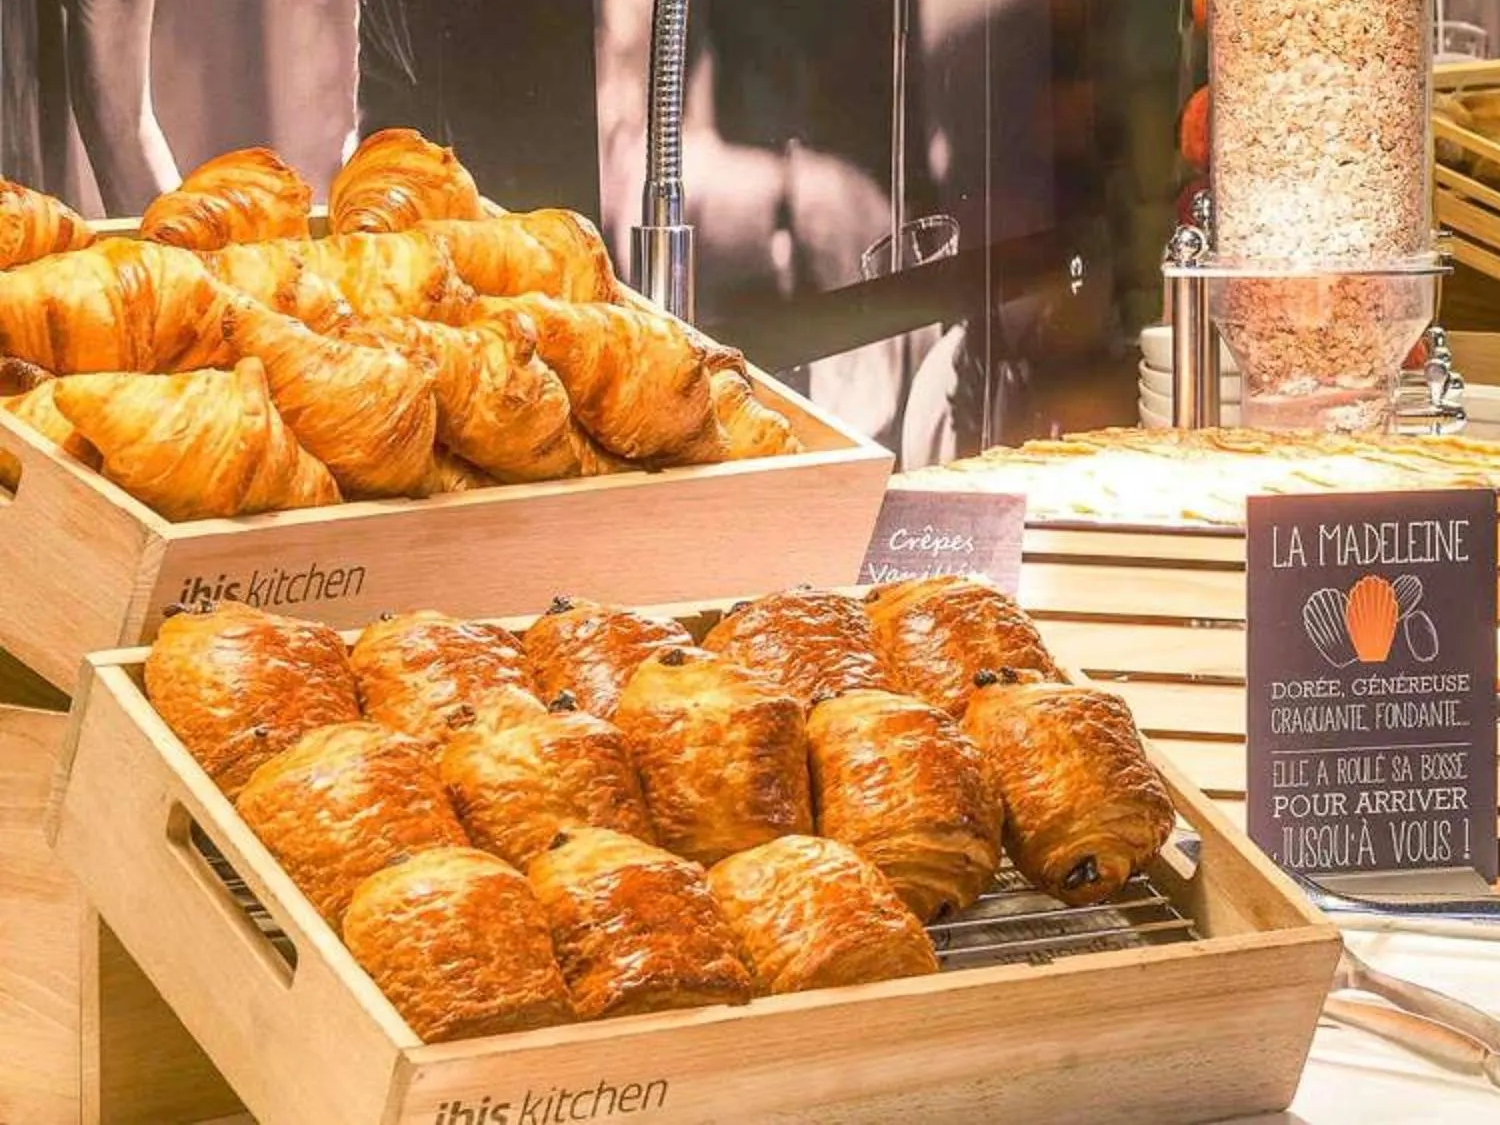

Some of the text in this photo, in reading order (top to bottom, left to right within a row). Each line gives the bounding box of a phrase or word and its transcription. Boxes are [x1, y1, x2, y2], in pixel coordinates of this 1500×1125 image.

[889, 525, 975, 557] Crêpes
[1272, 520, 1469, 568] LA MADELEINE
[246, 563, 366, 609] kitchen
[1272, 673, 1471, 700] DORÉE, GÉNÉREUSE
[1274, 752, 1468, 788] ELLE A ROULÉ SA BOSSE
[1273, 786, 1469, 819] POUR ARRIVER
[1272, 817, 1471, 869] JUSQU'À VOUS !
[518, 1079, 669, 1125] kitchen
